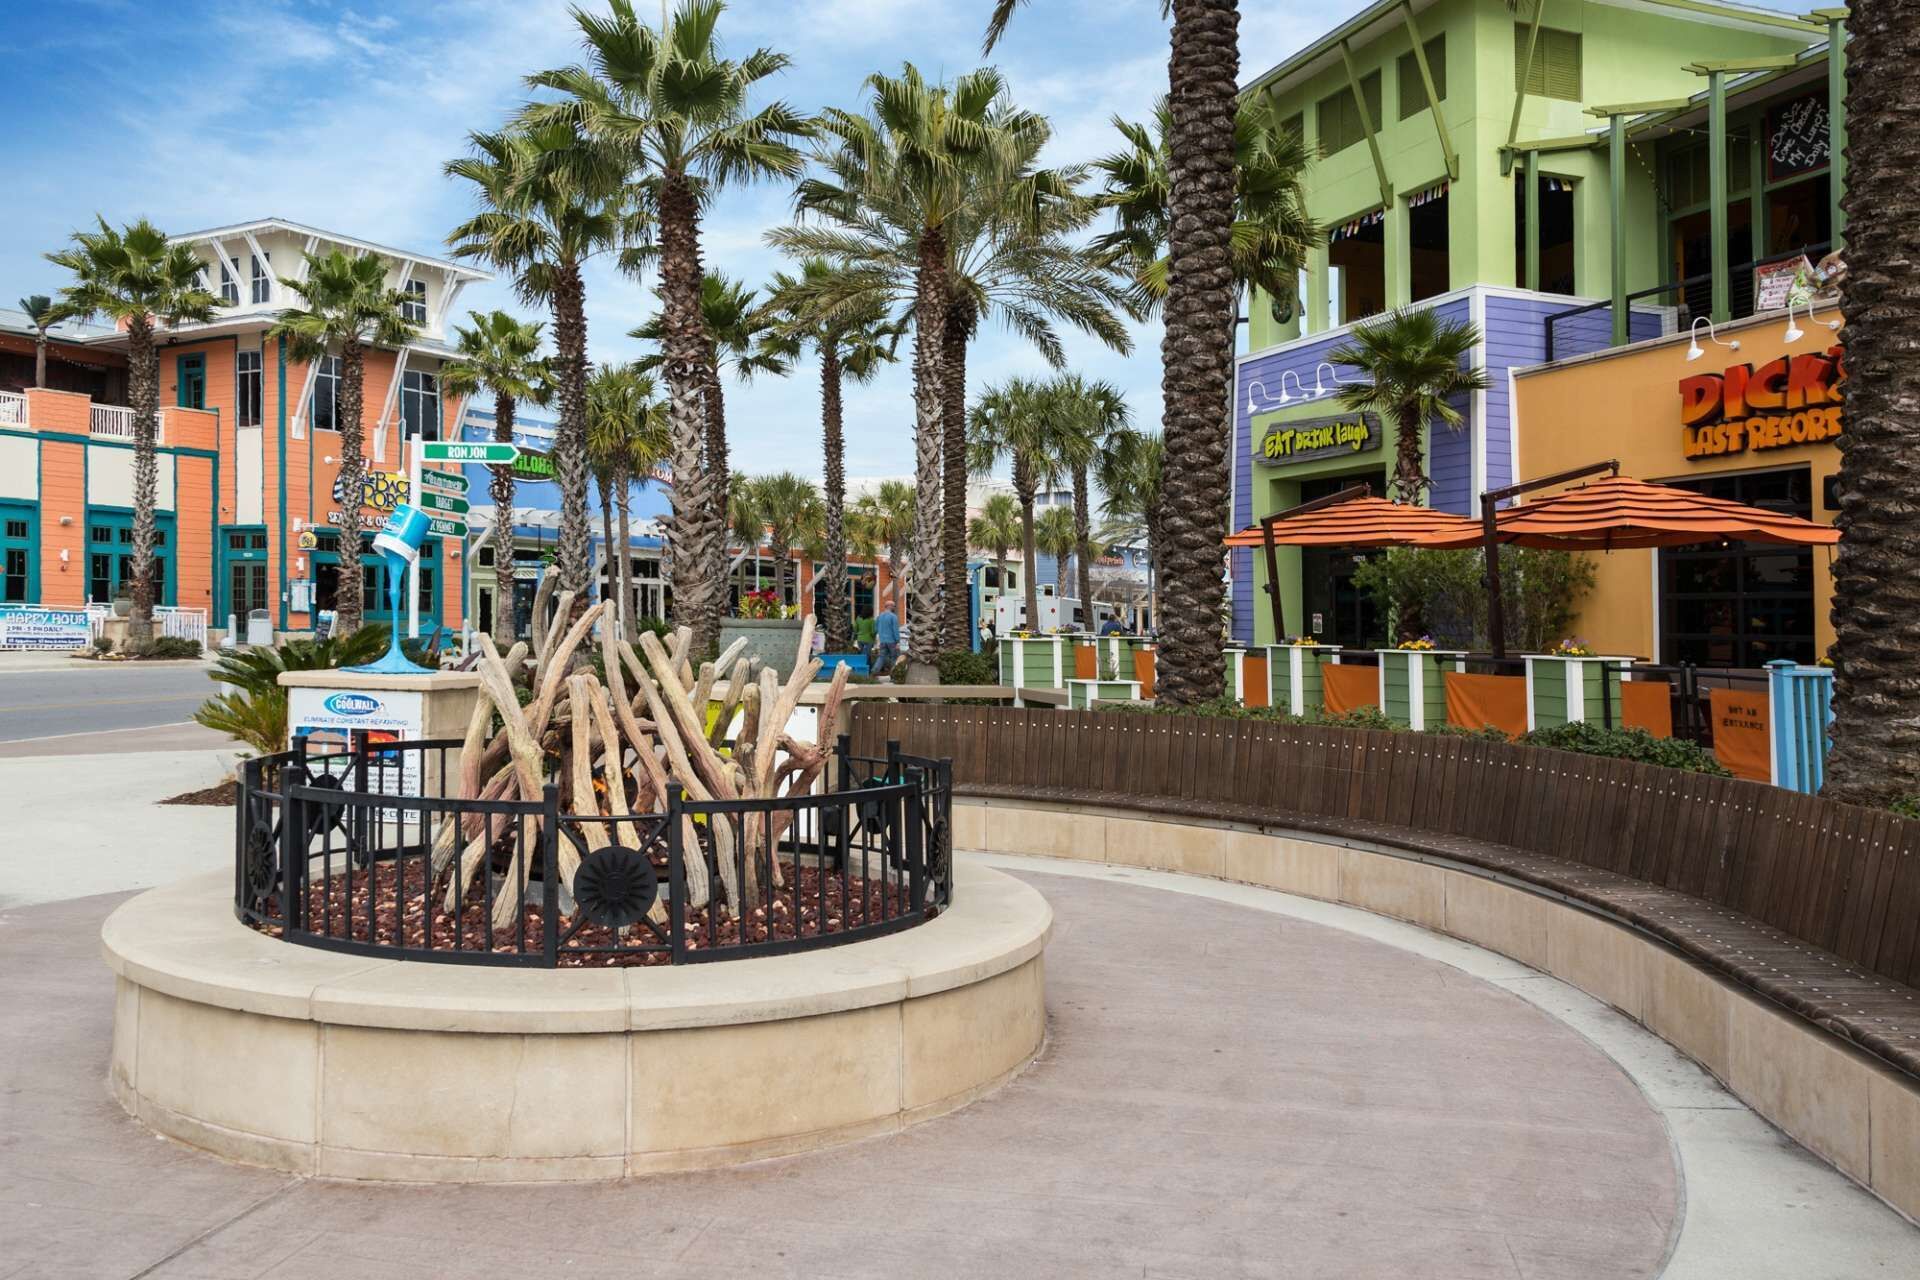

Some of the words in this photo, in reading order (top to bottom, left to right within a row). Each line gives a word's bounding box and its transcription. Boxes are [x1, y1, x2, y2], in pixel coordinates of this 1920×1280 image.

[1264, 429, 1295, 458] EAT
[1296, 426, 1334, 450] DRINK
[1336, 414, 1369, 450] laugh
[1683, 421, 1746, 458] LAST
[1746, 406, 1843, 450] RESORT
[448, 446, 468, 458] RON
[469, 446, 488, 459] JON
[6, 612, 48, 625] HAPPY
[51, 613, 86, 625] HOUR
[335, 698, 374, 710] COOLWALL
